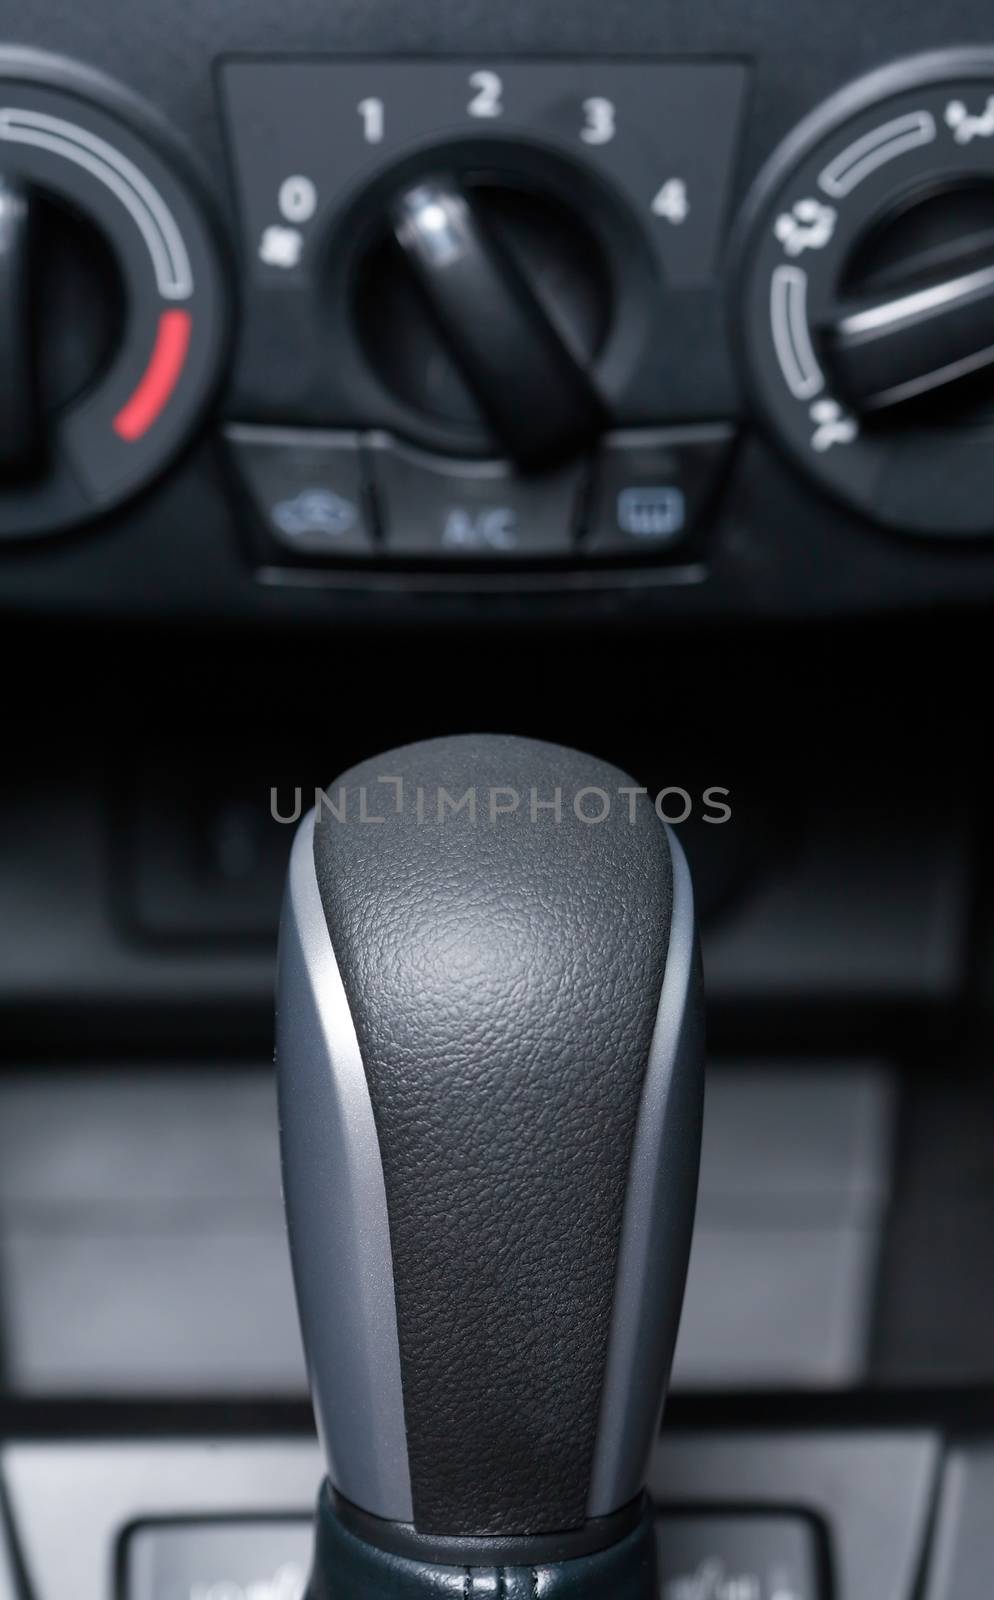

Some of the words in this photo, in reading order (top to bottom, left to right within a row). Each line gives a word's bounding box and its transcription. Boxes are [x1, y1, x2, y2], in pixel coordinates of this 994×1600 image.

[467, 70, 502, 118] 2
[357, 97, 385, 143] 1
[580, 97, 616, 144] 3
[651, 178, 689, 225] 4
